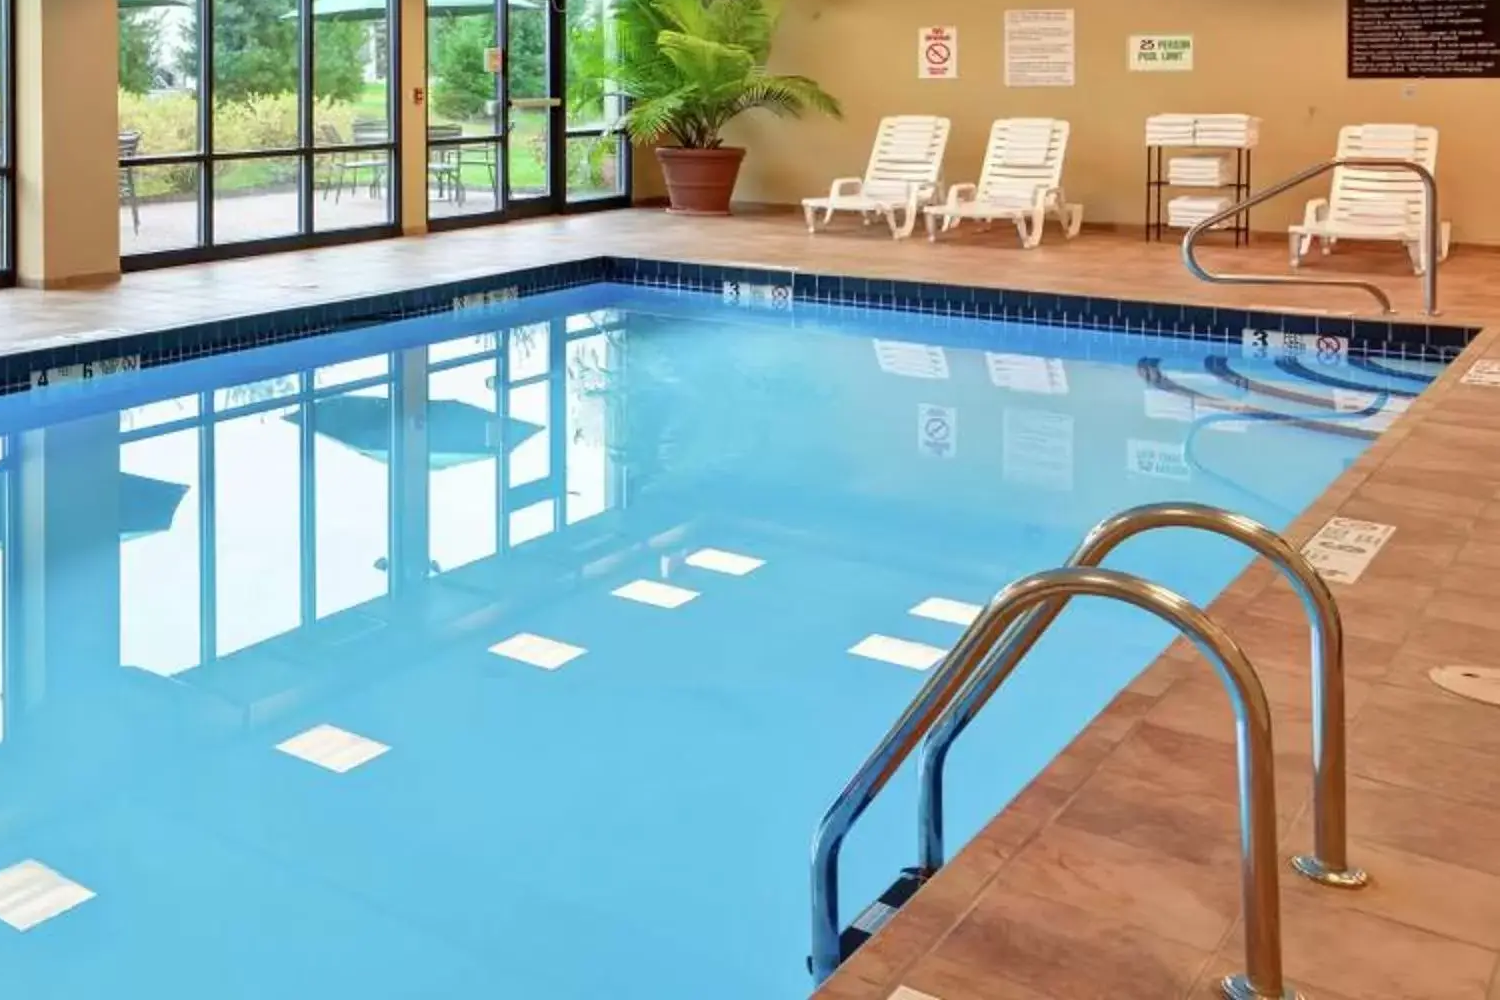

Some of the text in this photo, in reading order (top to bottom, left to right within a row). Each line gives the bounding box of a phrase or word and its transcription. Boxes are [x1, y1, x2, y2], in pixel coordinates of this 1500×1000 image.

[1140, 39, 1191, 50] 25 PERSON
[1138, 51, 1183, 61] POOL LIMIT
[1252, 329, 1268, 346] 3
[37, 367, 49, 386] 4
